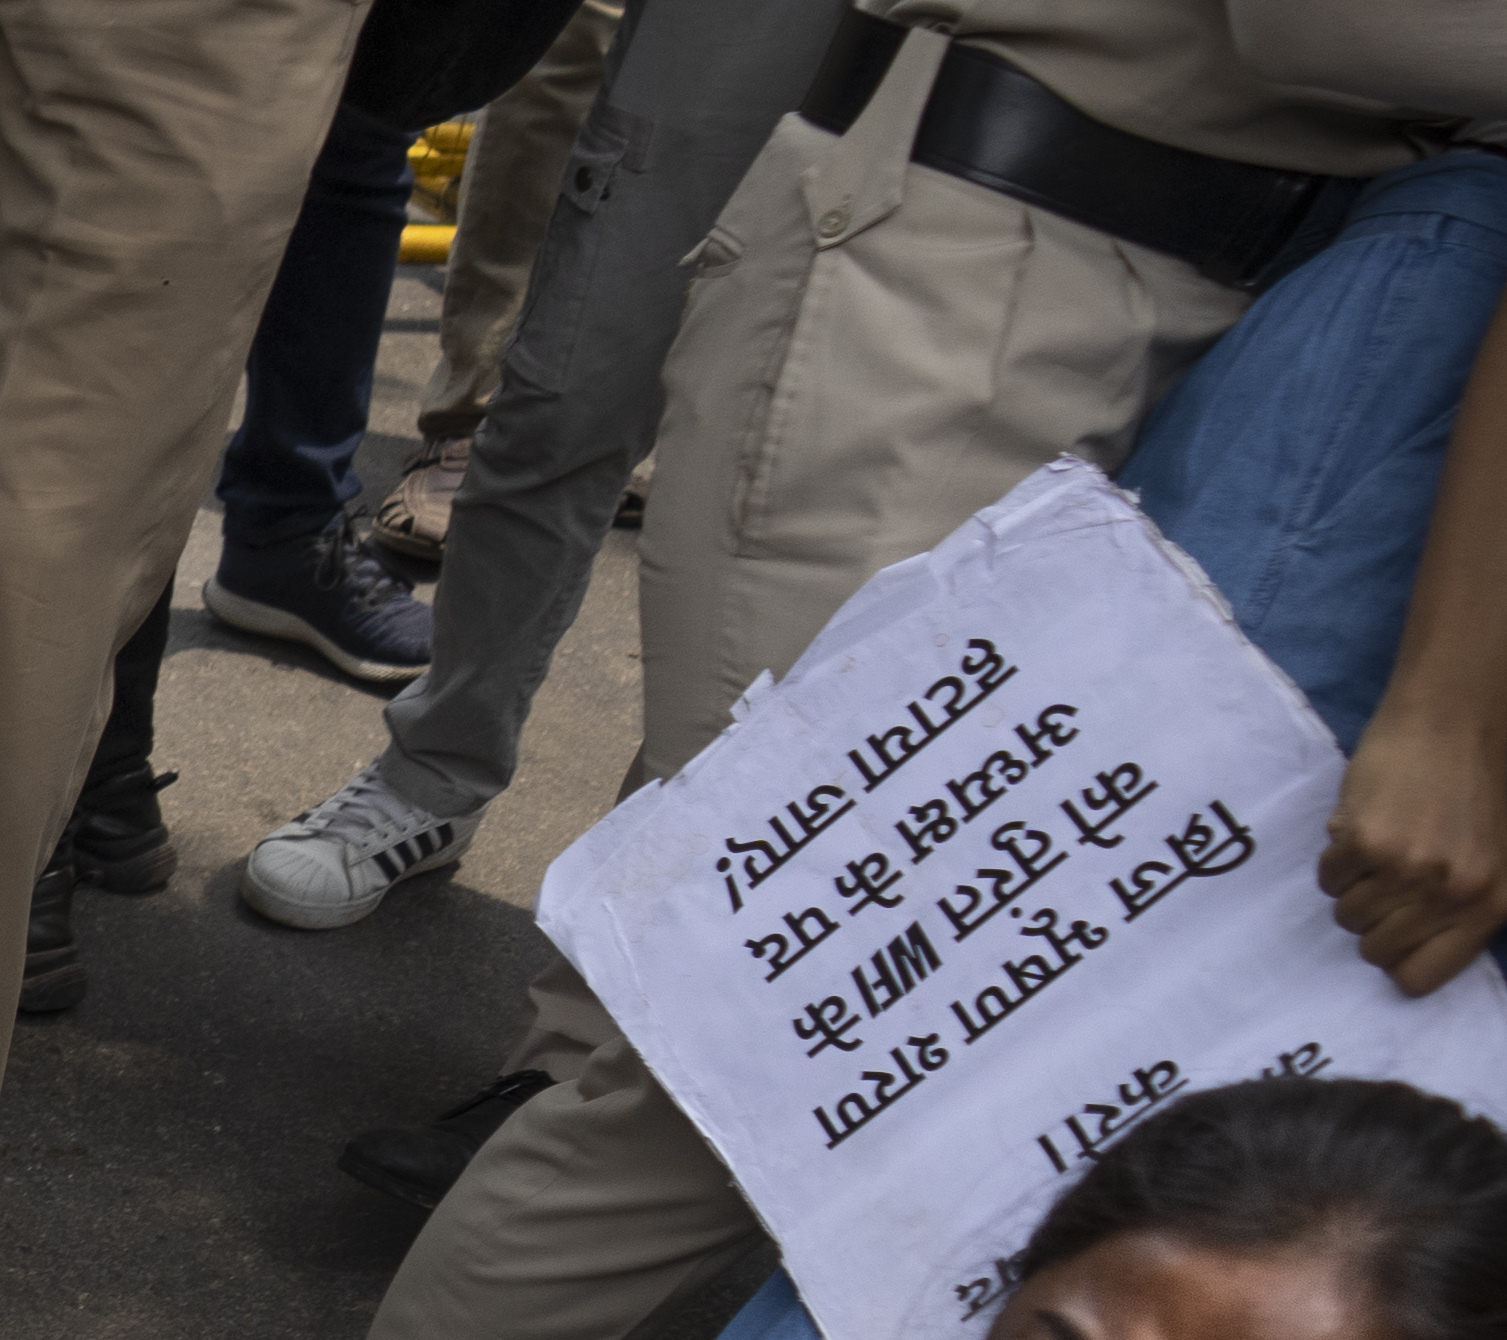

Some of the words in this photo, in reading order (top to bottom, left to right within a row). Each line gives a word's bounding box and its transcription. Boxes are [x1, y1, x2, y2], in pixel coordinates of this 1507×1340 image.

[847, 638, 1019, 794] हटाया
[894, 703, 1080, 865] अध्यक्ष
[1059, 762, 1160, 849] को
[715, 784, 857, 914] जाए!
[834, 852, 905, 917] के
[936, 820, 1070, 943] तुरंत
[1108, 799, 1257, 923] ब्रिज
[744, 907, 842, 984] पद
[850, 920, 943, 1018] WFI
[949, 907, 1110, 1045] भूषण
[792, 995, 864, 1059] के
[812, 1032, 950, 1150] शरण
[1037, 1059, 1190, 1174] करो।
